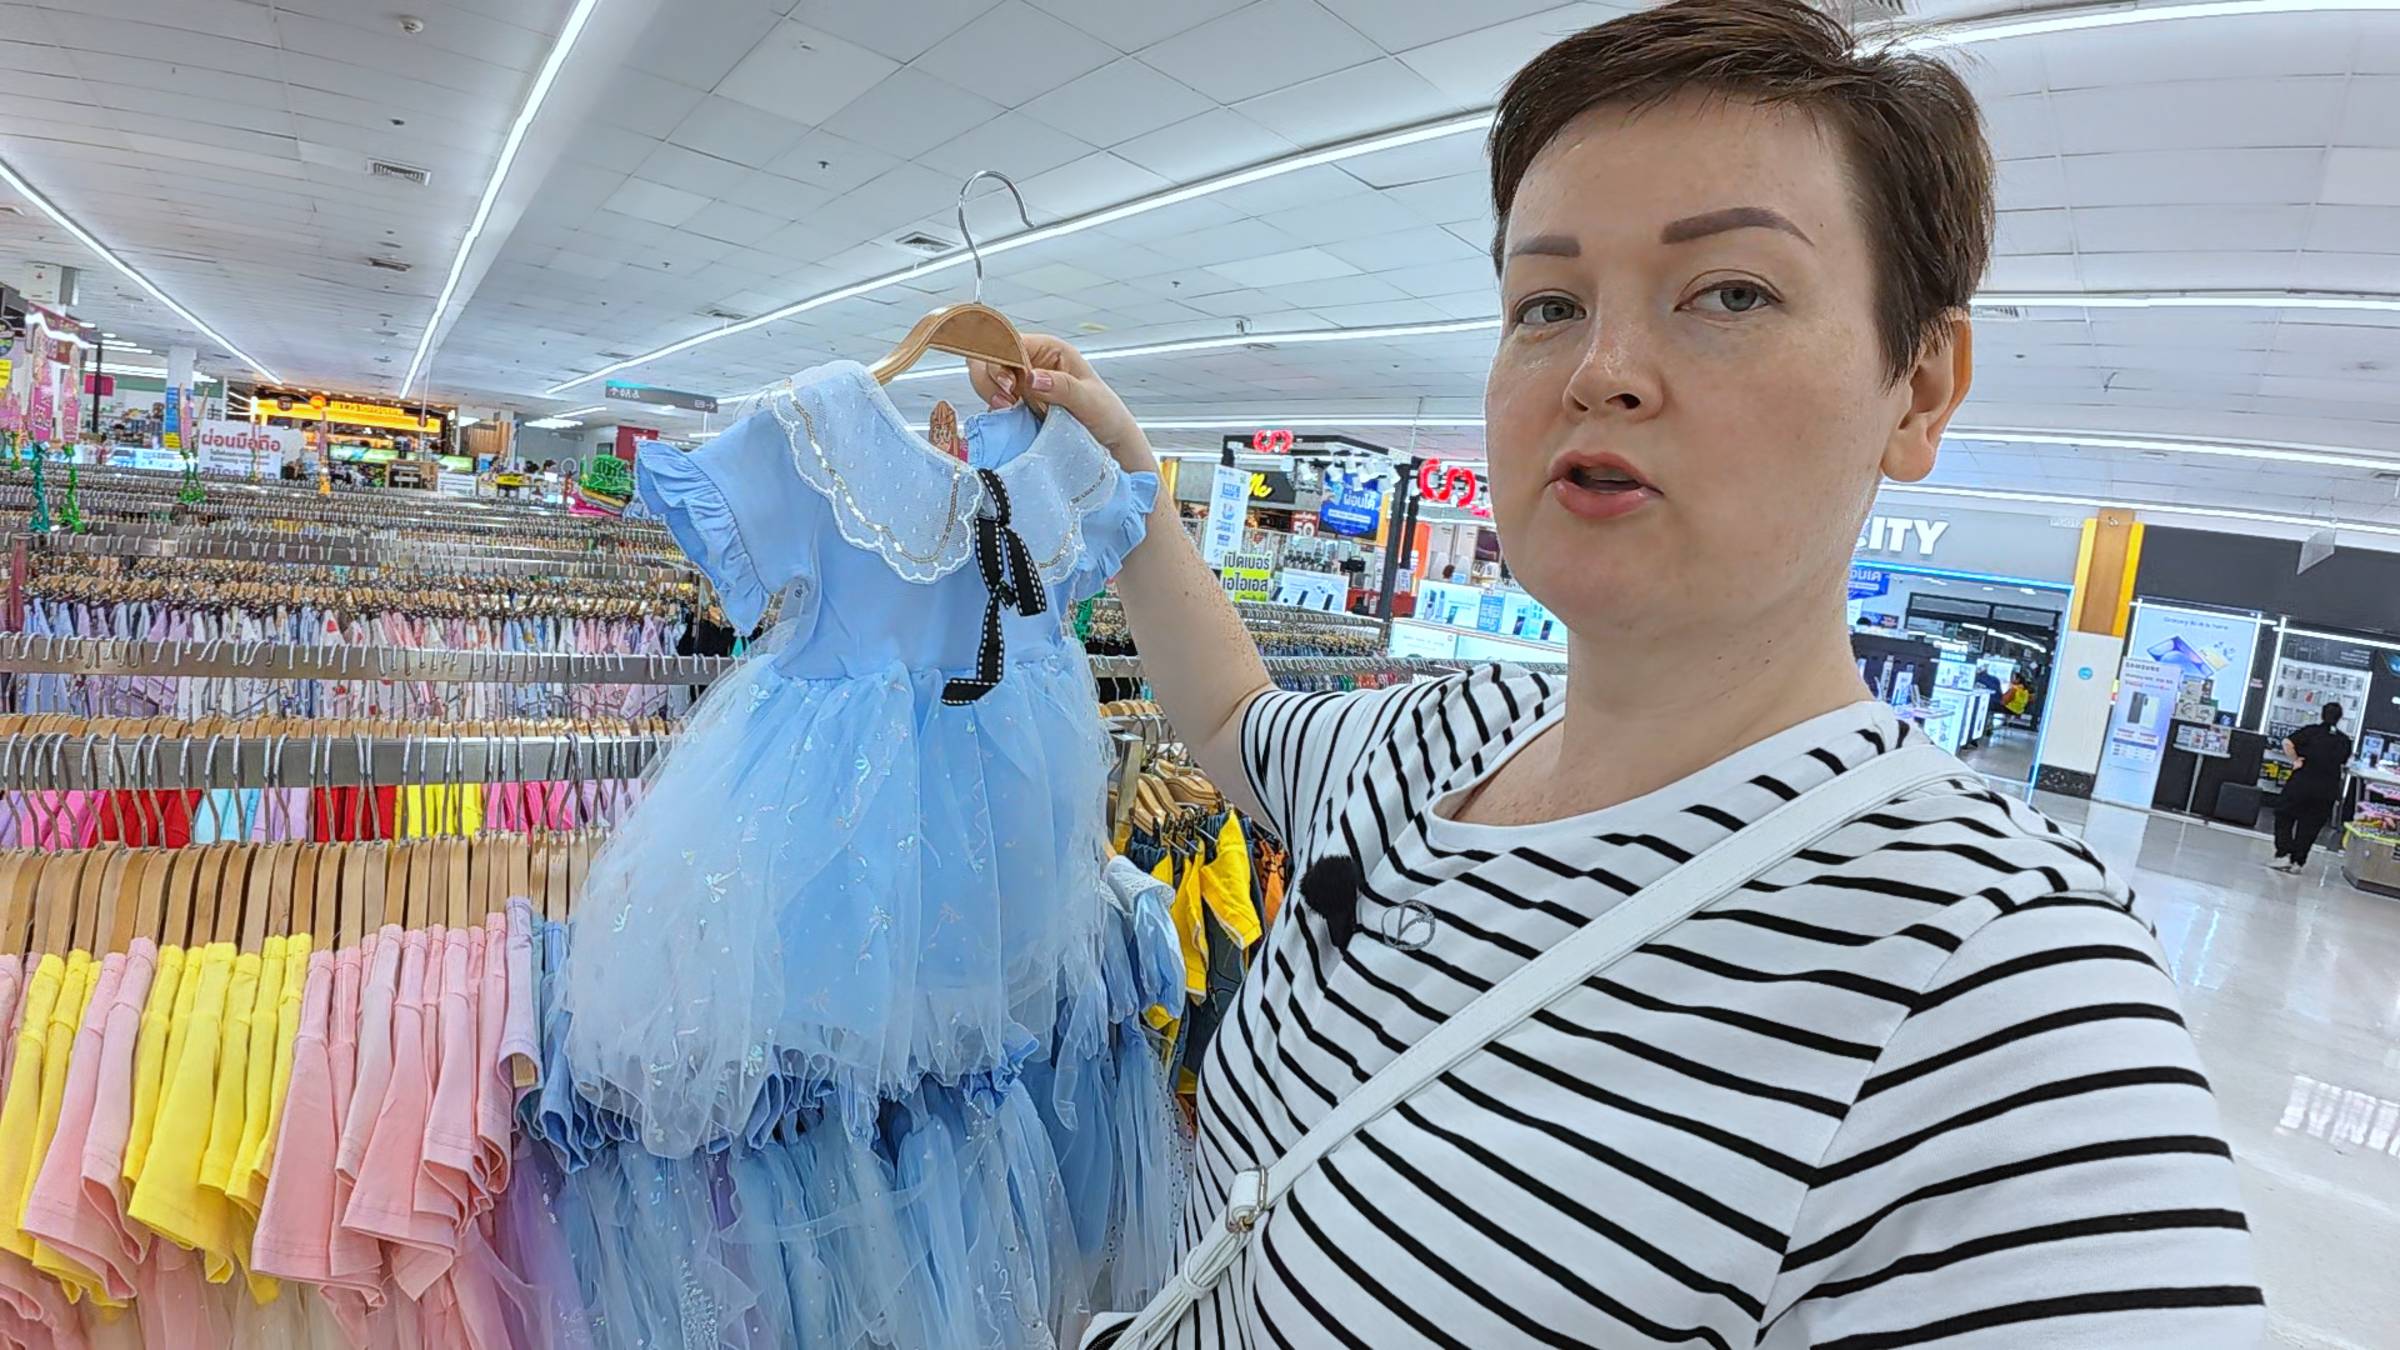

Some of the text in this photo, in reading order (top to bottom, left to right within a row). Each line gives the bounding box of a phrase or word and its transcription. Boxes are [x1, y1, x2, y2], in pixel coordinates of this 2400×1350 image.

[201, 428, 281, 452] ผ่อนมือถือ
[1857, 516, 1949, 555] ITY
[1222, 572, 1269, 592] เอไอเอส
